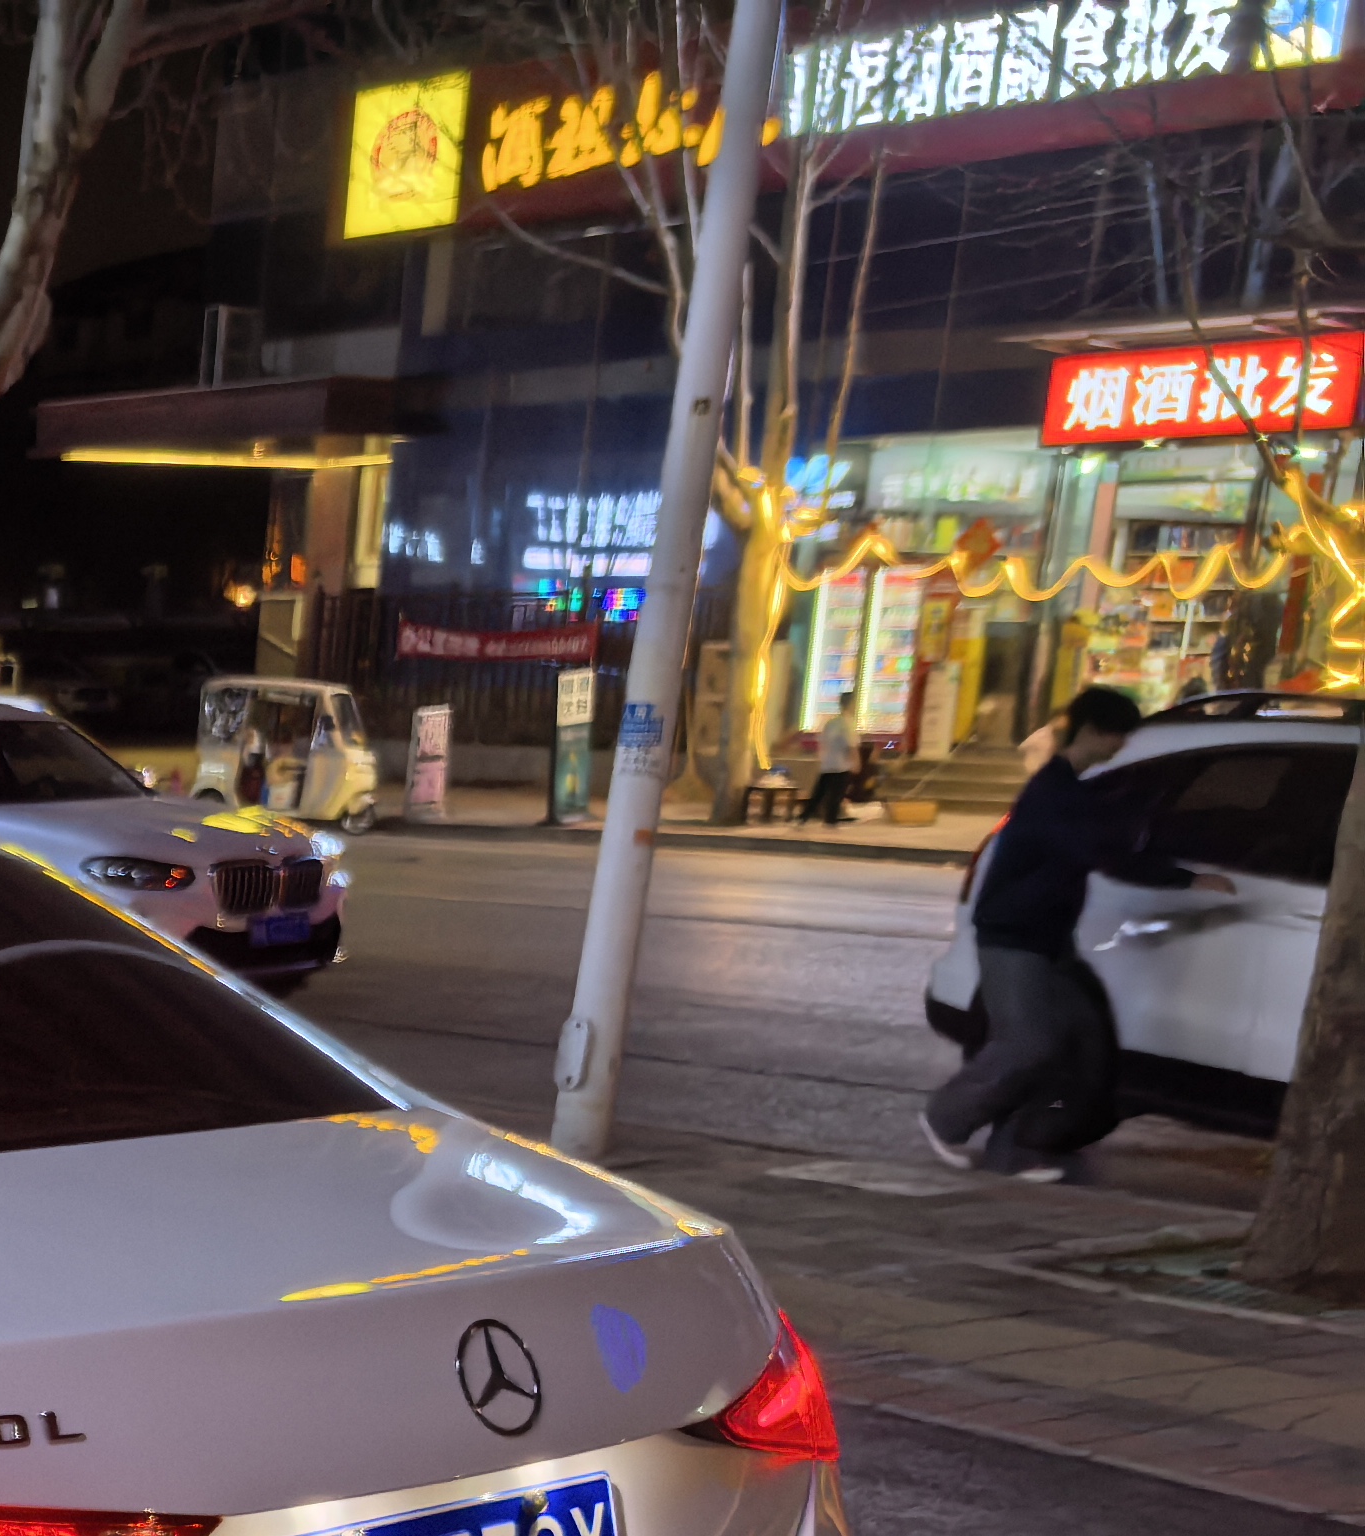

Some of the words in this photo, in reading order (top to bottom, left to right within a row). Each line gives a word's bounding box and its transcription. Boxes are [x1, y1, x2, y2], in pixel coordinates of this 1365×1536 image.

[1063, 352, 1339, 430] 烟酒批发
[38, 1410, 87, 1445] L
